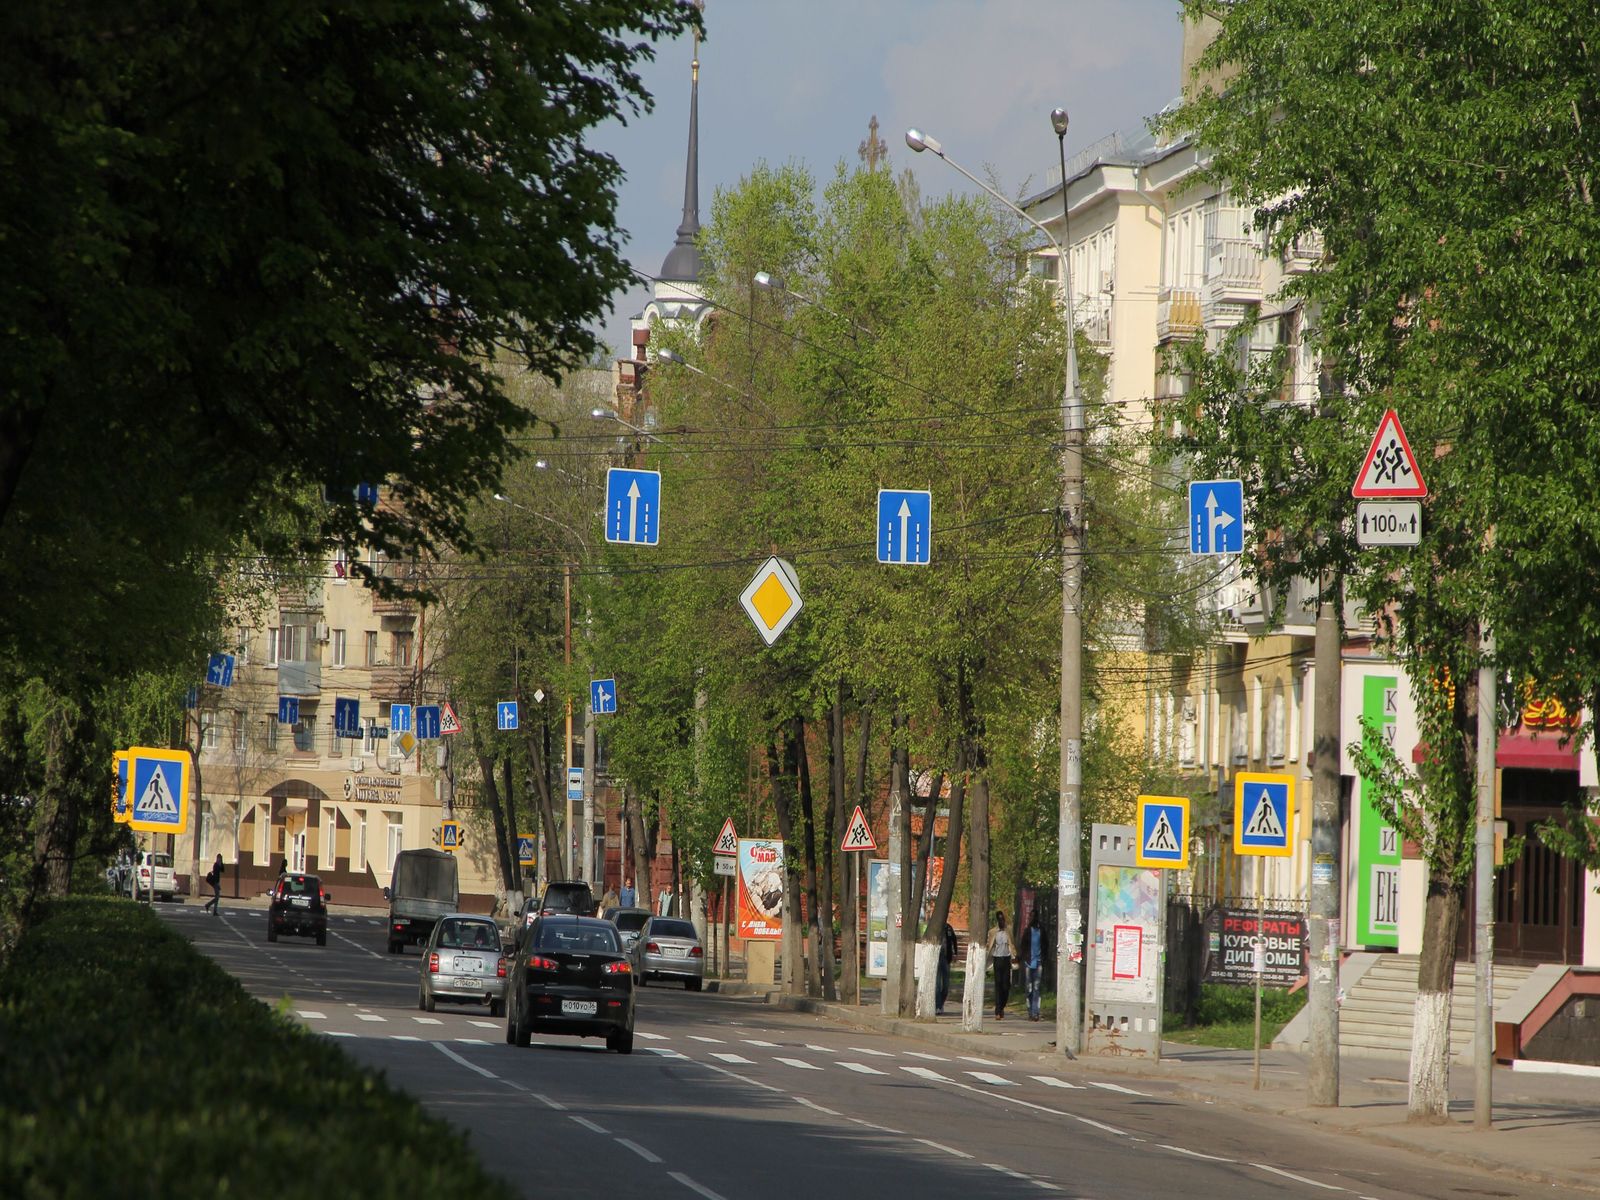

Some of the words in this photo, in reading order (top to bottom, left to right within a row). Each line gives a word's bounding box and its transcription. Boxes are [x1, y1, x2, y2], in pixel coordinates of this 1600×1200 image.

[1371, 515, 1397, 532] 100
[1224, 918, 1300, 935] РЕФЕРАТЫ
[1224, 950, 1300, 966] ДИПОМЫ
